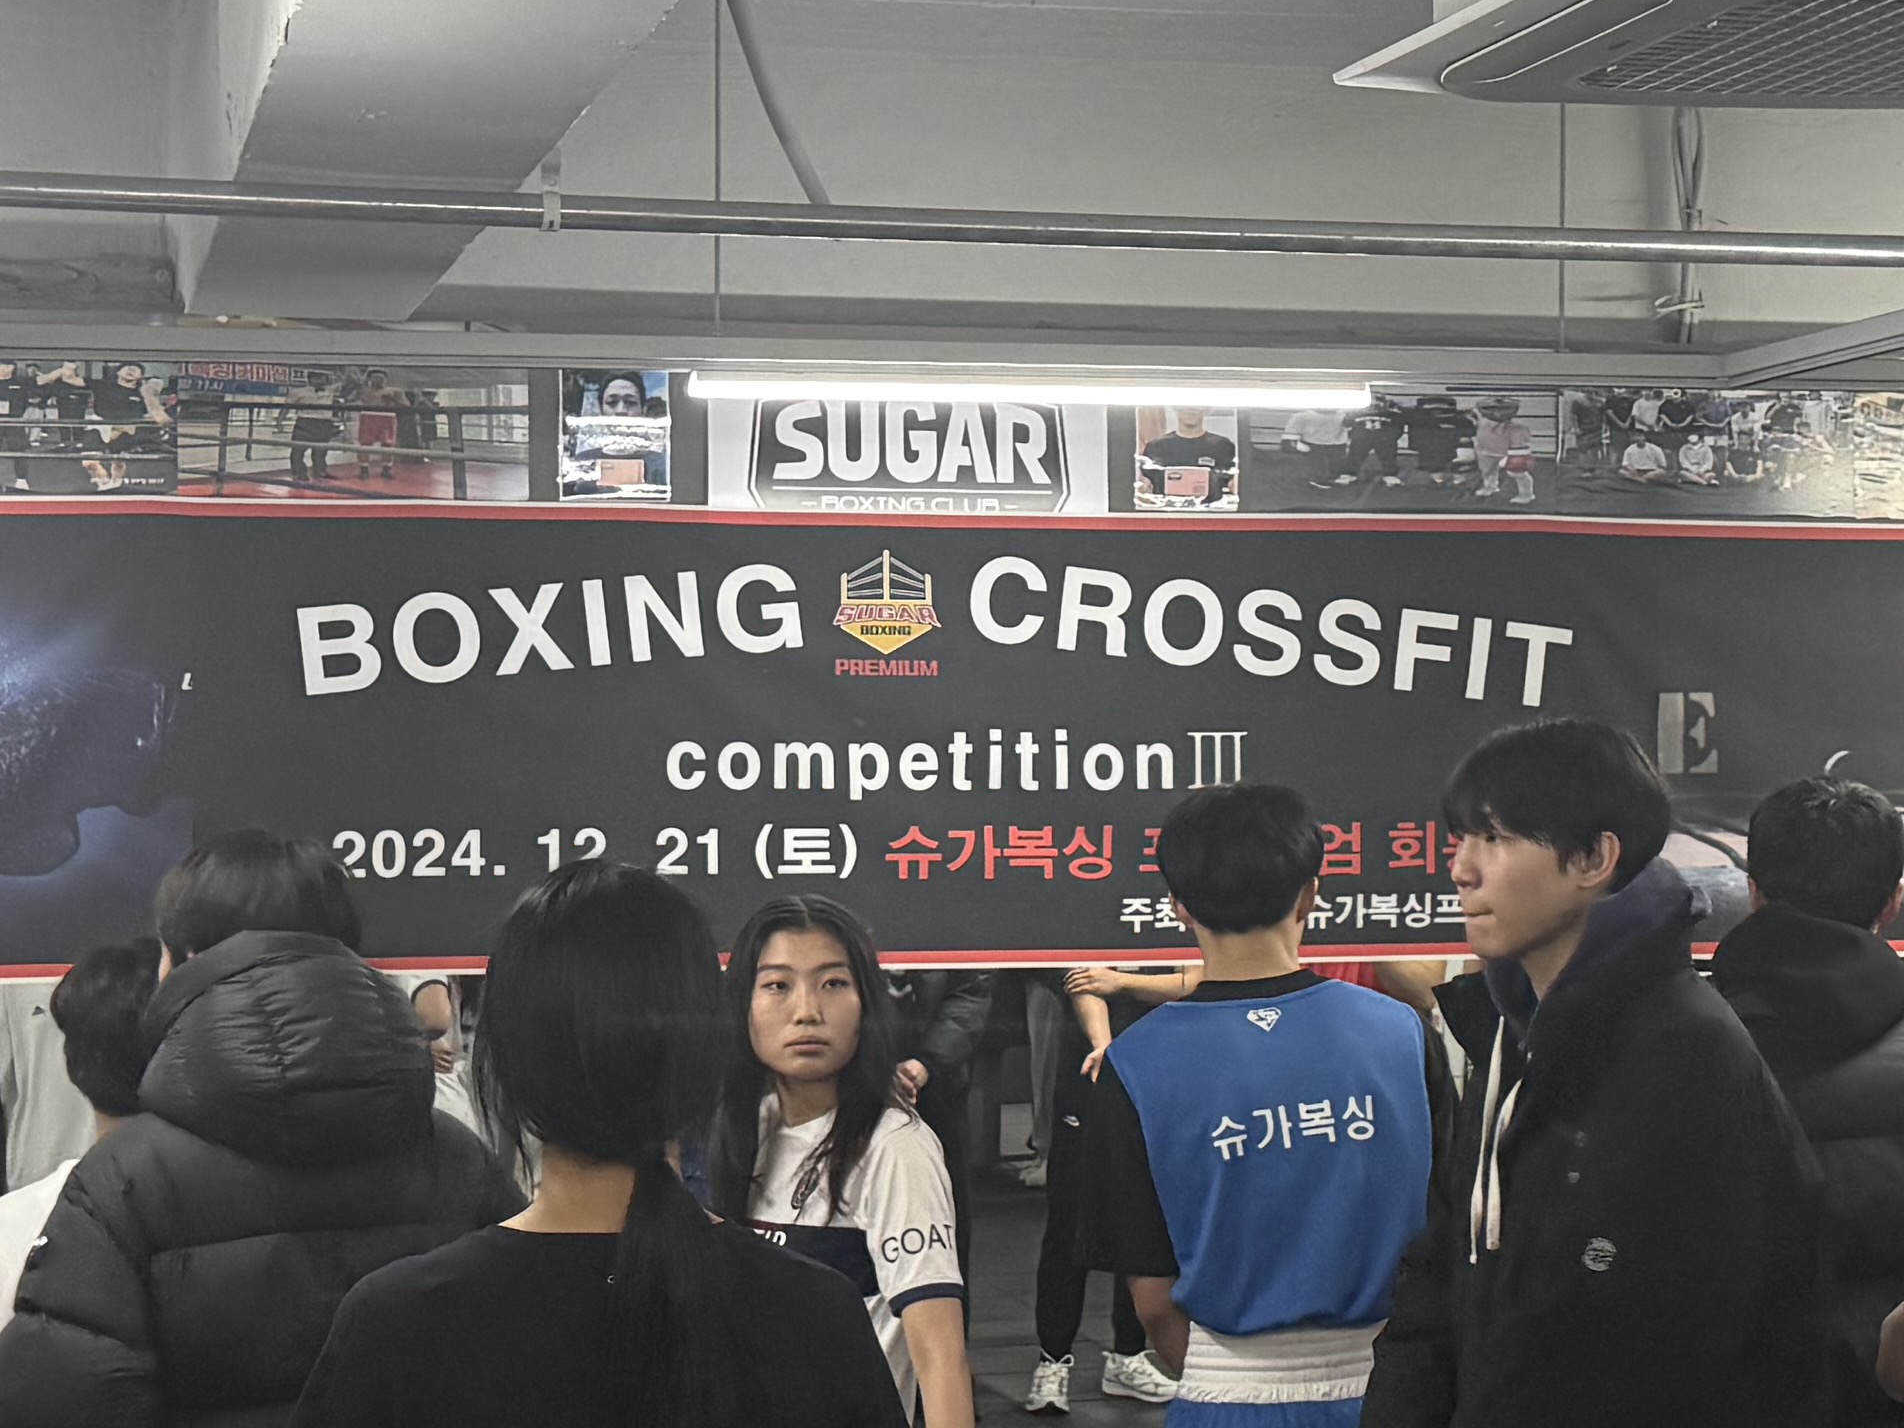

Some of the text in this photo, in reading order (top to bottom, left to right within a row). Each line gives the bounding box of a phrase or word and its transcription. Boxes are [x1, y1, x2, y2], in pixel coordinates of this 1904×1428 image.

[772, 401, 1052, 485] SUGAR
[296, 556, 1573, 707] BOXING CROSSFIT
[833, 604, 942, 628] SUGAR
[860, 625, 912, 636] BOXING
[834, 659, 940, 677] PREMIUM
[332, 828, 506, 879] 2024.
[754, 822, 857, 880] (토)
[885, 825, 1113, 881] 슈가복싱
[1210, 1094, 1376, 1161] 슈가복싱
